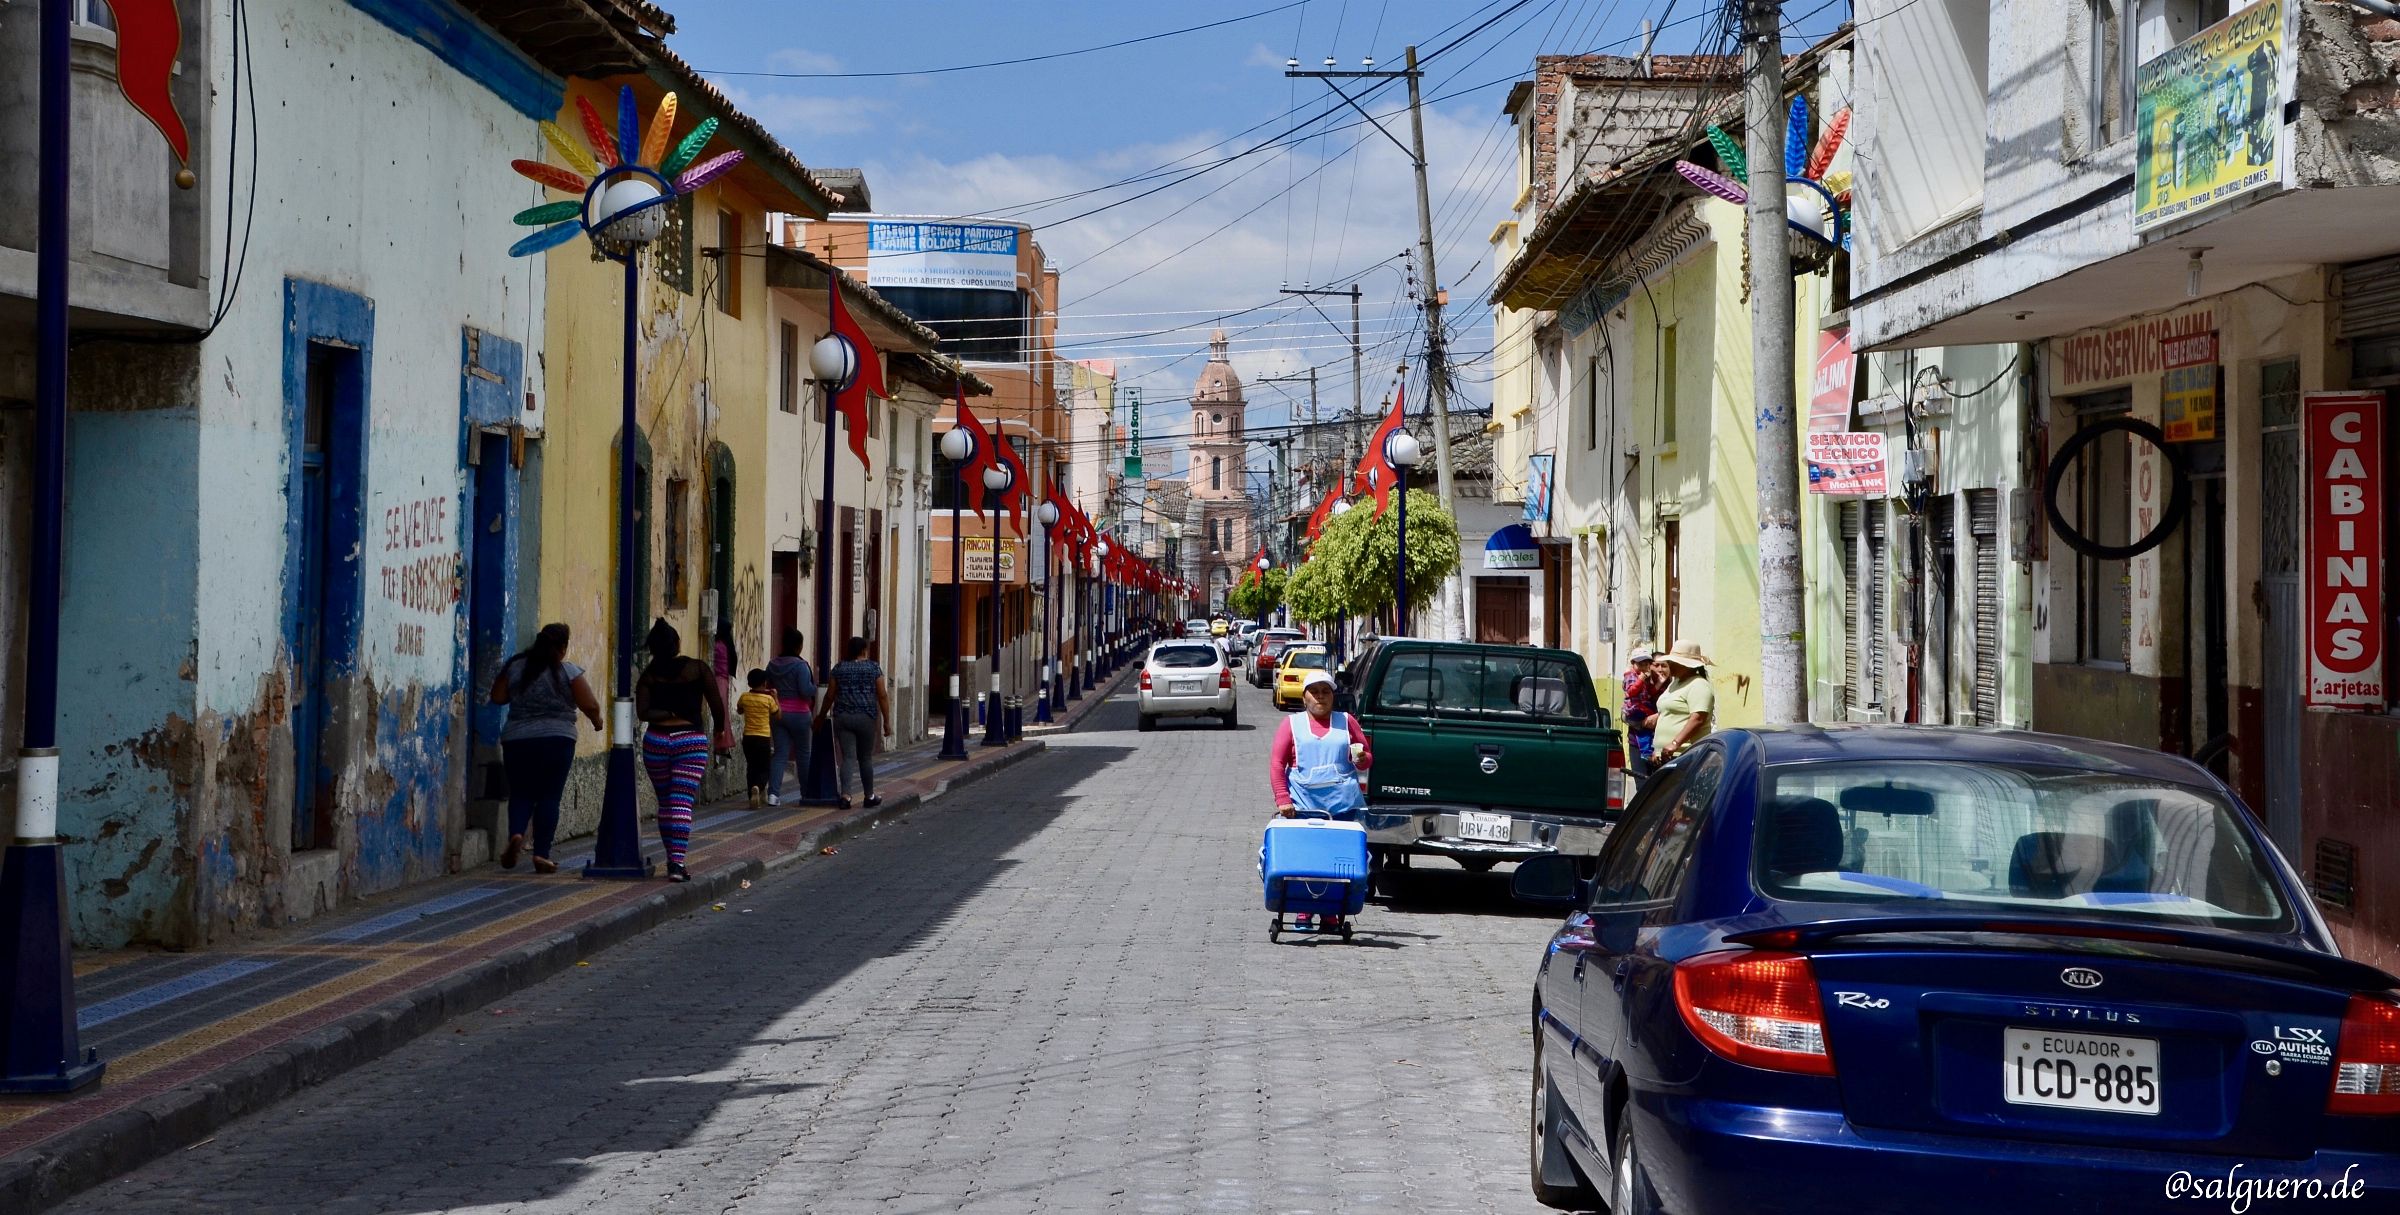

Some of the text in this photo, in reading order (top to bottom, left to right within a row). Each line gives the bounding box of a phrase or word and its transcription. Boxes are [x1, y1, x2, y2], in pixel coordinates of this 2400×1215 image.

[2140, 55, 2167, 92] VIDEO
[2171, 37, 2208, 80] MASTER
[2228, 2, 2277, 50] FERCHO
[2190, 191, 2211, 207] TIENDA
[2243, 168, 2268, 188] GAMES
[920, 277, 956, 285] ABIERTAS
[961, 279, 984, 287] CUPOS
[985, 279, 1014, 288] LIMITADOS
[2064, 335, 2100, 386] MOTO
[2104, 317, 2172, 381] SERVICIO
[1131, 401, 1139, 428] Sana
[1131, 429, 1139, 456] Sana
[1809, 434, 1881, 446] SERVICIO
[1811, 446, 1879, 459] TÉCNICO
[1829, 477, 1883, 490] MobiLINK
[385, 496, 446, 551] SE VENDE
[2325, 411, 2369, 660] CABINAS
[1381, 785, 1431, 796] FRONTIER
[1460, 821, 1509, 839] UBV-438
[1833, 991, 1890, 1009] Rio
[2025, 1005, 2142, 1024] STYLUS
[2274, 1025, 2326, 1043] LSX
[2043, 1037, 2120, 1058] ECUADOR
[2278, 1041, 2332, 1056] AUTHESA
[2281, 1051, 2330, 1061] IBARRA ECUADOR
[2016, 1056, 2155, 1106] ICD-885
